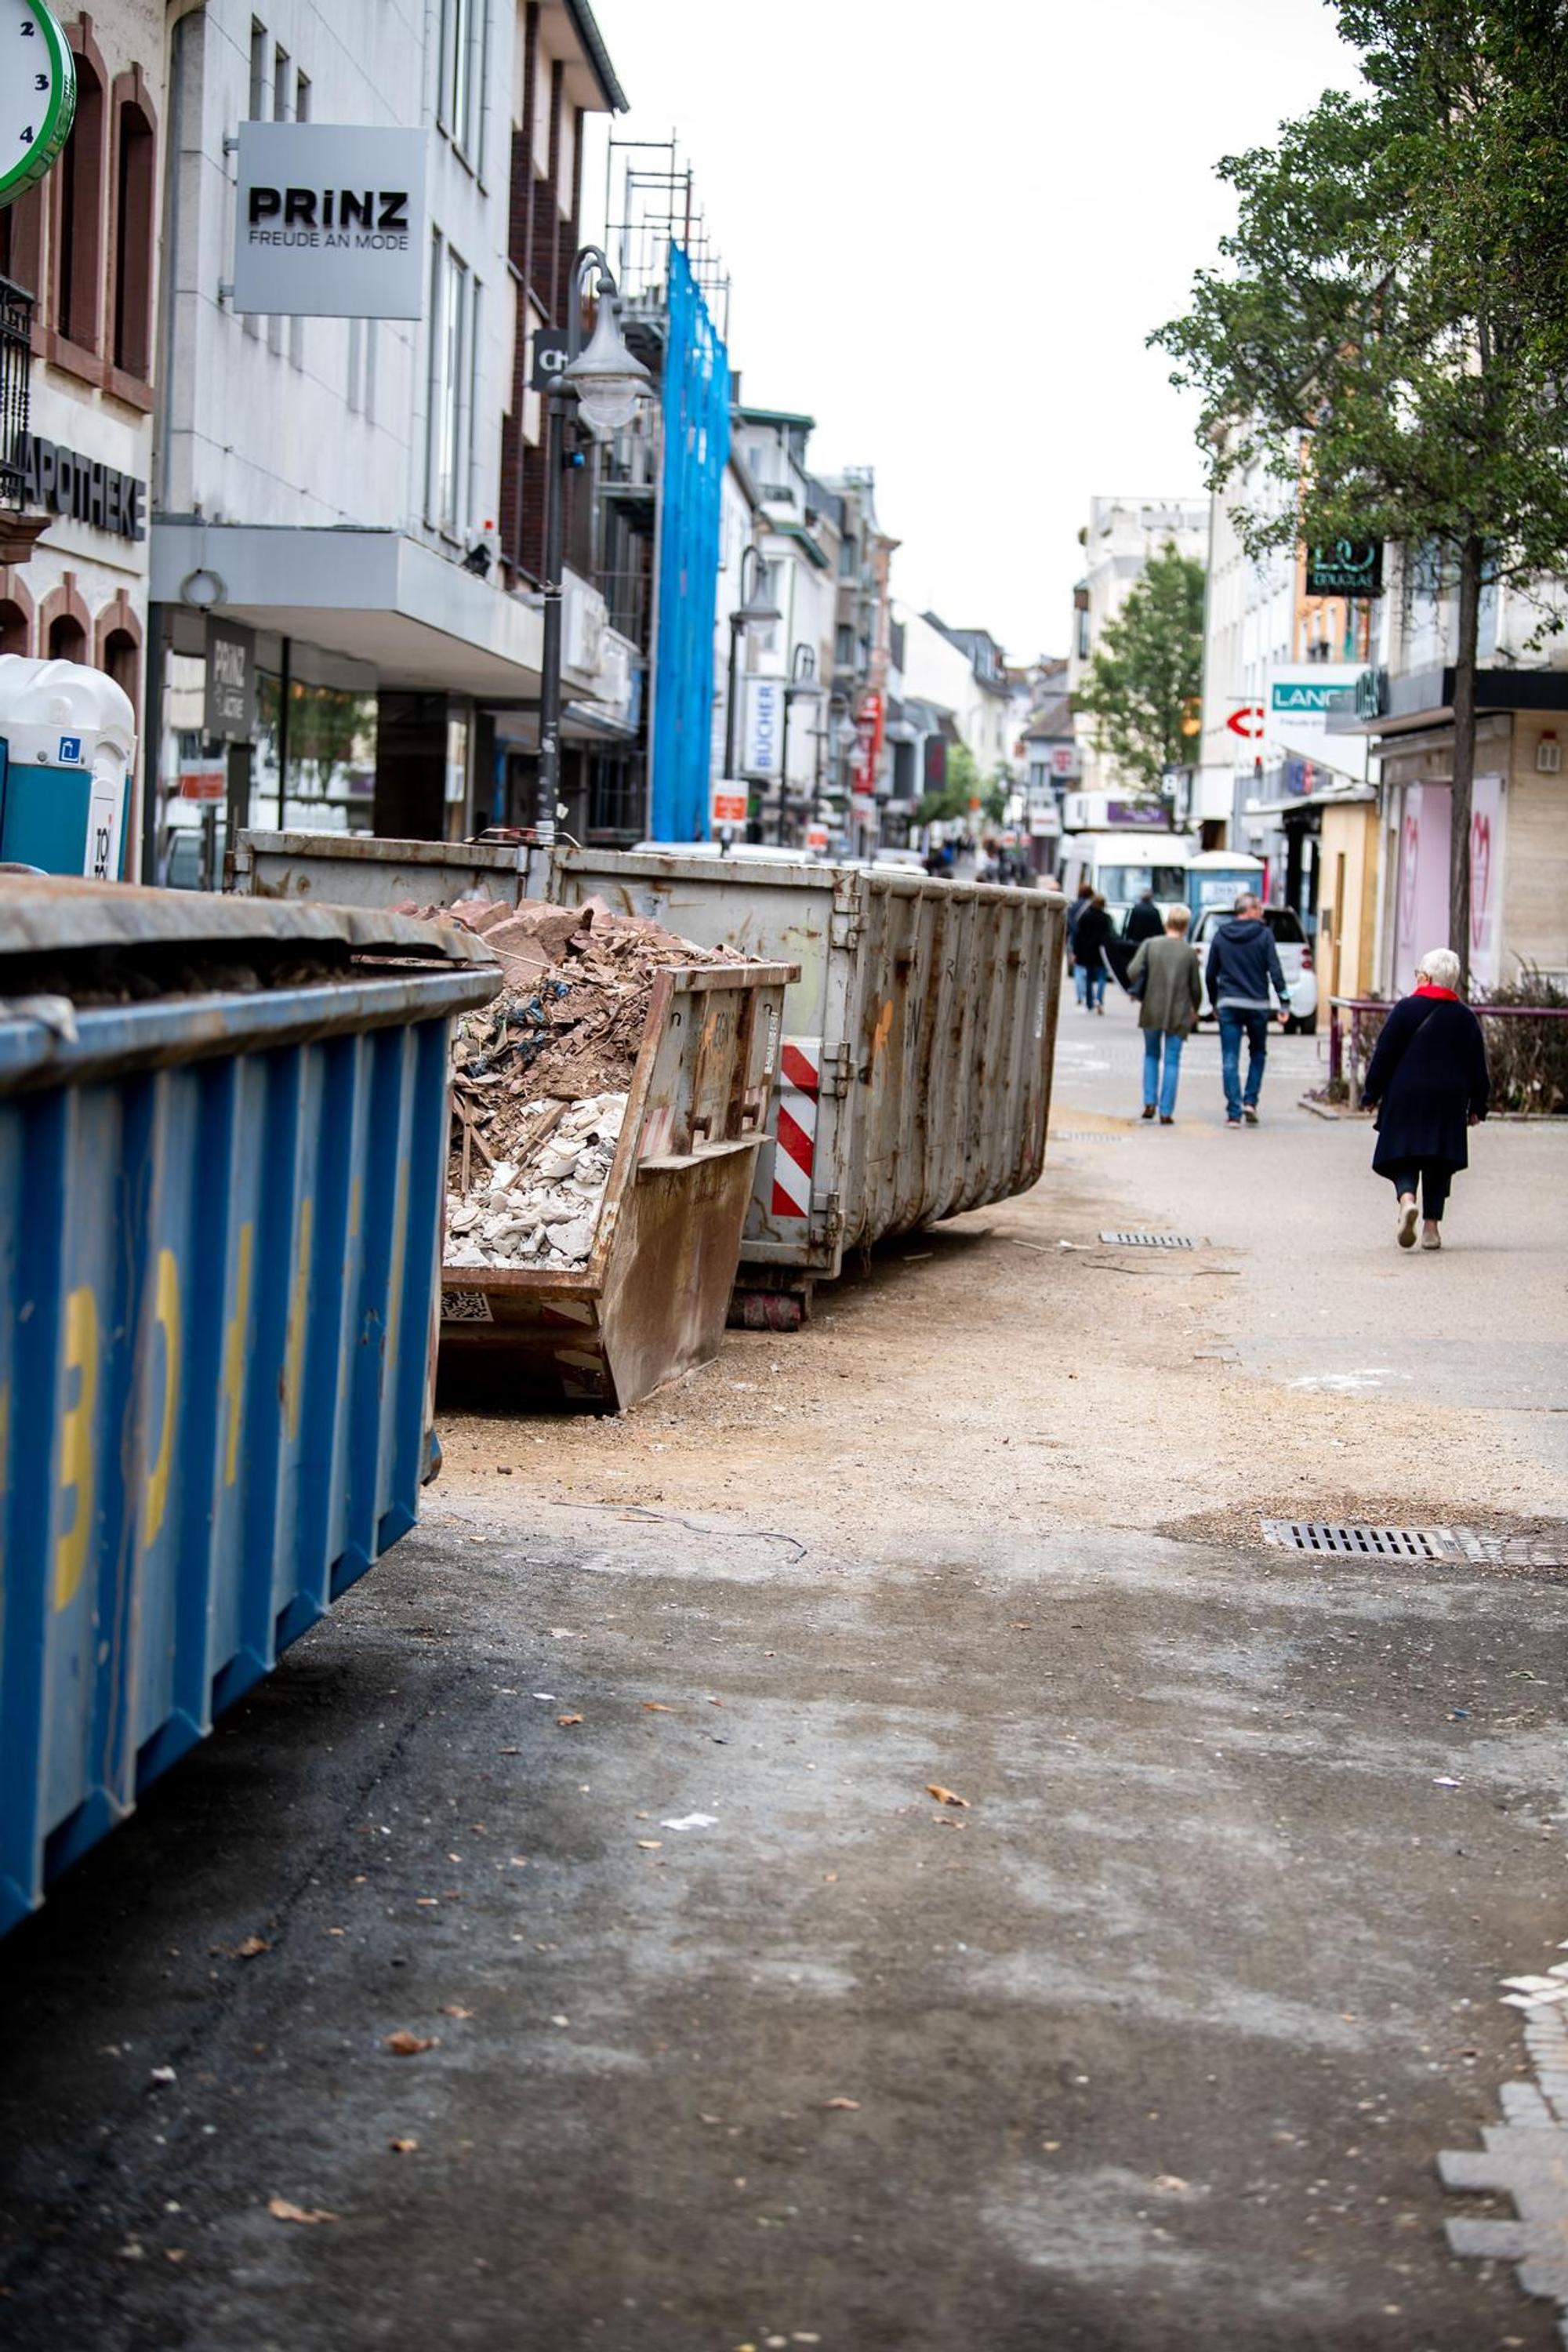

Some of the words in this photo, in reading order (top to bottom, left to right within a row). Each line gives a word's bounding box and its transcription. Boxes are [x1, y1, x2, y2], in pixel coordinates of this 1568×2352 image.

[20, 22, 34, 37] 2
[34, 74, 49, 91] 3
[20, 126, 34, 143] 4
[249, 187, 408, 229] PRiNZ
[249, 230, 320, 247] FREUDE
[324, 234, 350, 249] AN
[356, 236, 408, 250] MODE
[22, 431, 146, 541] APOTHEKE
